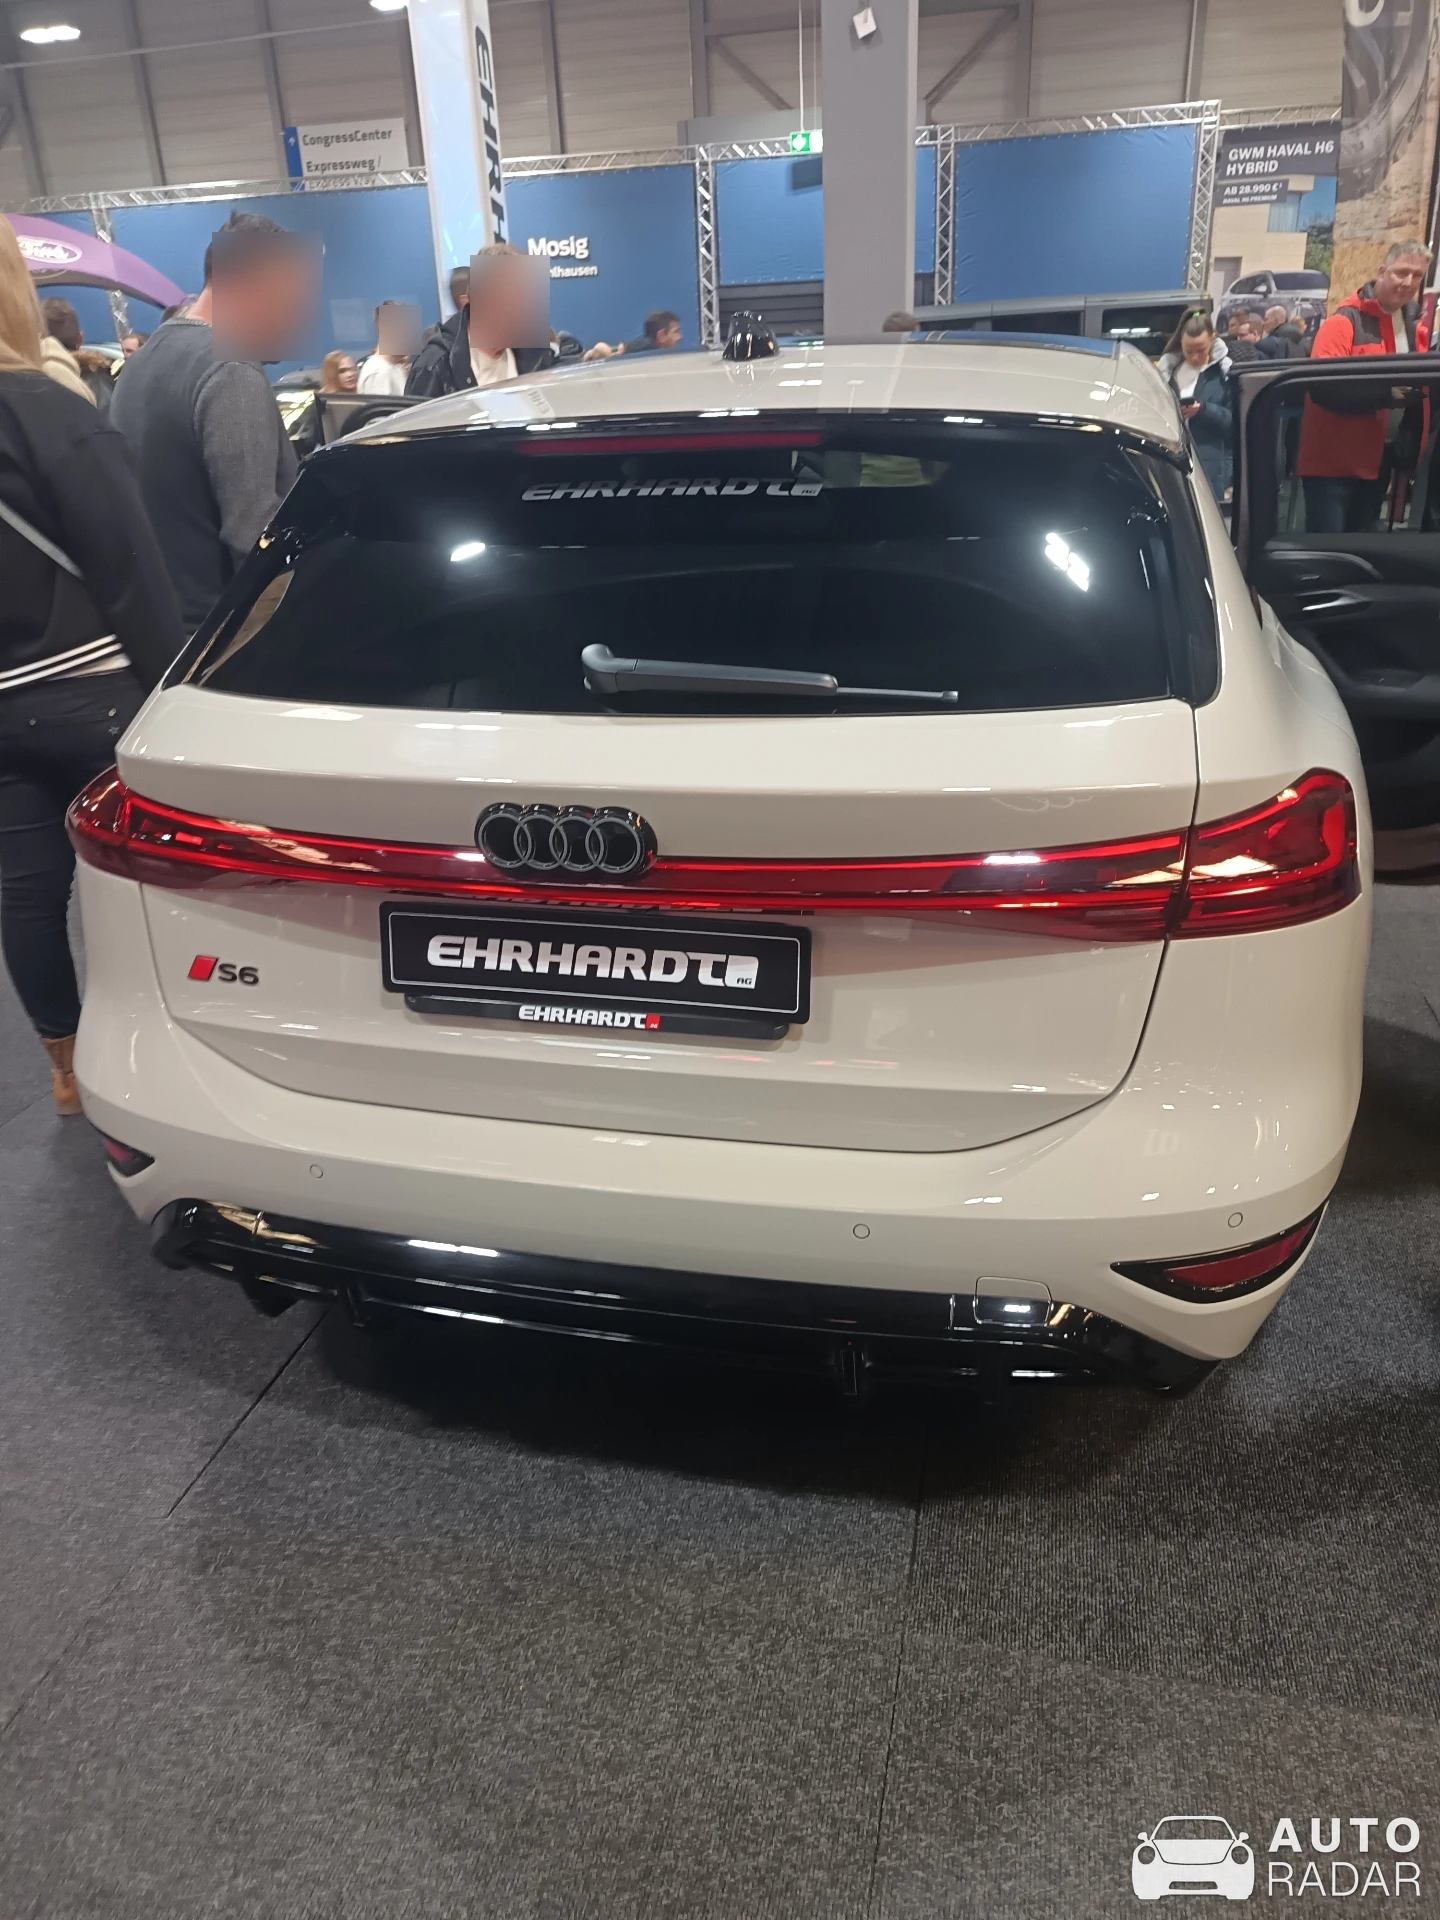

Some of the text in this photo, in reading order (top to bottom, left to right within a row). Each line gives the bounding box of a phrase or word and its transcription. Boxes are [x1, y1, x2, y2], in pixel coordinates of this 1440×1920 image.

[302, 129, 393, 148] CongressCenter
[1228, 140, 1335, 162] GWM HAVAL H6
[306, 158, 376, 175] Expressweg
[1226, 160, 1279, 176] HYBRID
[1223, 186, 1238, 196] AB
[527, 236, 589, 259] Mosig
[521, 477, 799, 501] EHRHARDT
[426, 934, 753, 987] EHRHARDT AG
[217, 963, 260, 986] S6
[518, 1004, 648, 1029] EHRHARDT
